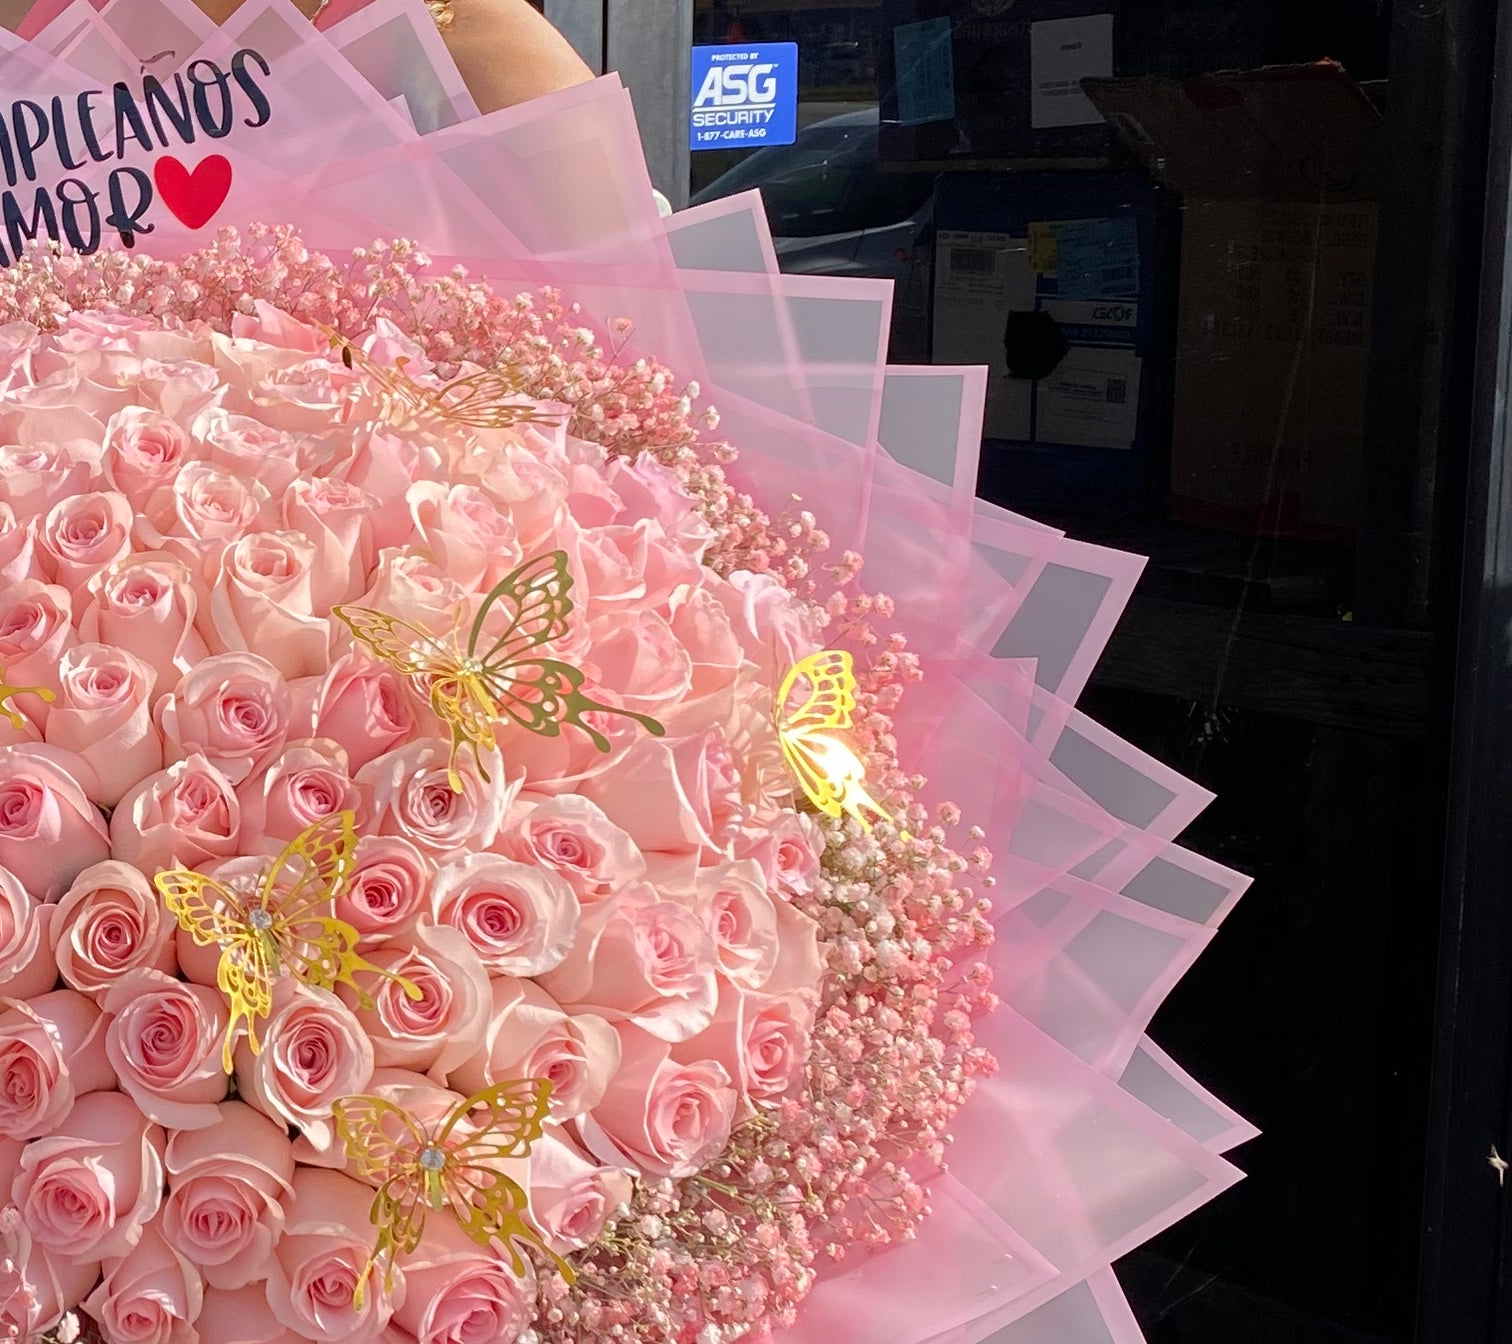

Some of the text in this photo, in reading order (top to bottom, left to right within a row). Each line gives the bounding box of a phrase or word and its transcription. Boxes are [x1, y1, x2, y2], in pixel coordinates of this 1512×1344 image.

[711, 52, 759, 62] PROTECTED BY
[692, 63, 776, 106] ASG
[692, 110, 775, 127] SECURITY
[696, 128, 767, 142] 1-877-CARE-ASG
